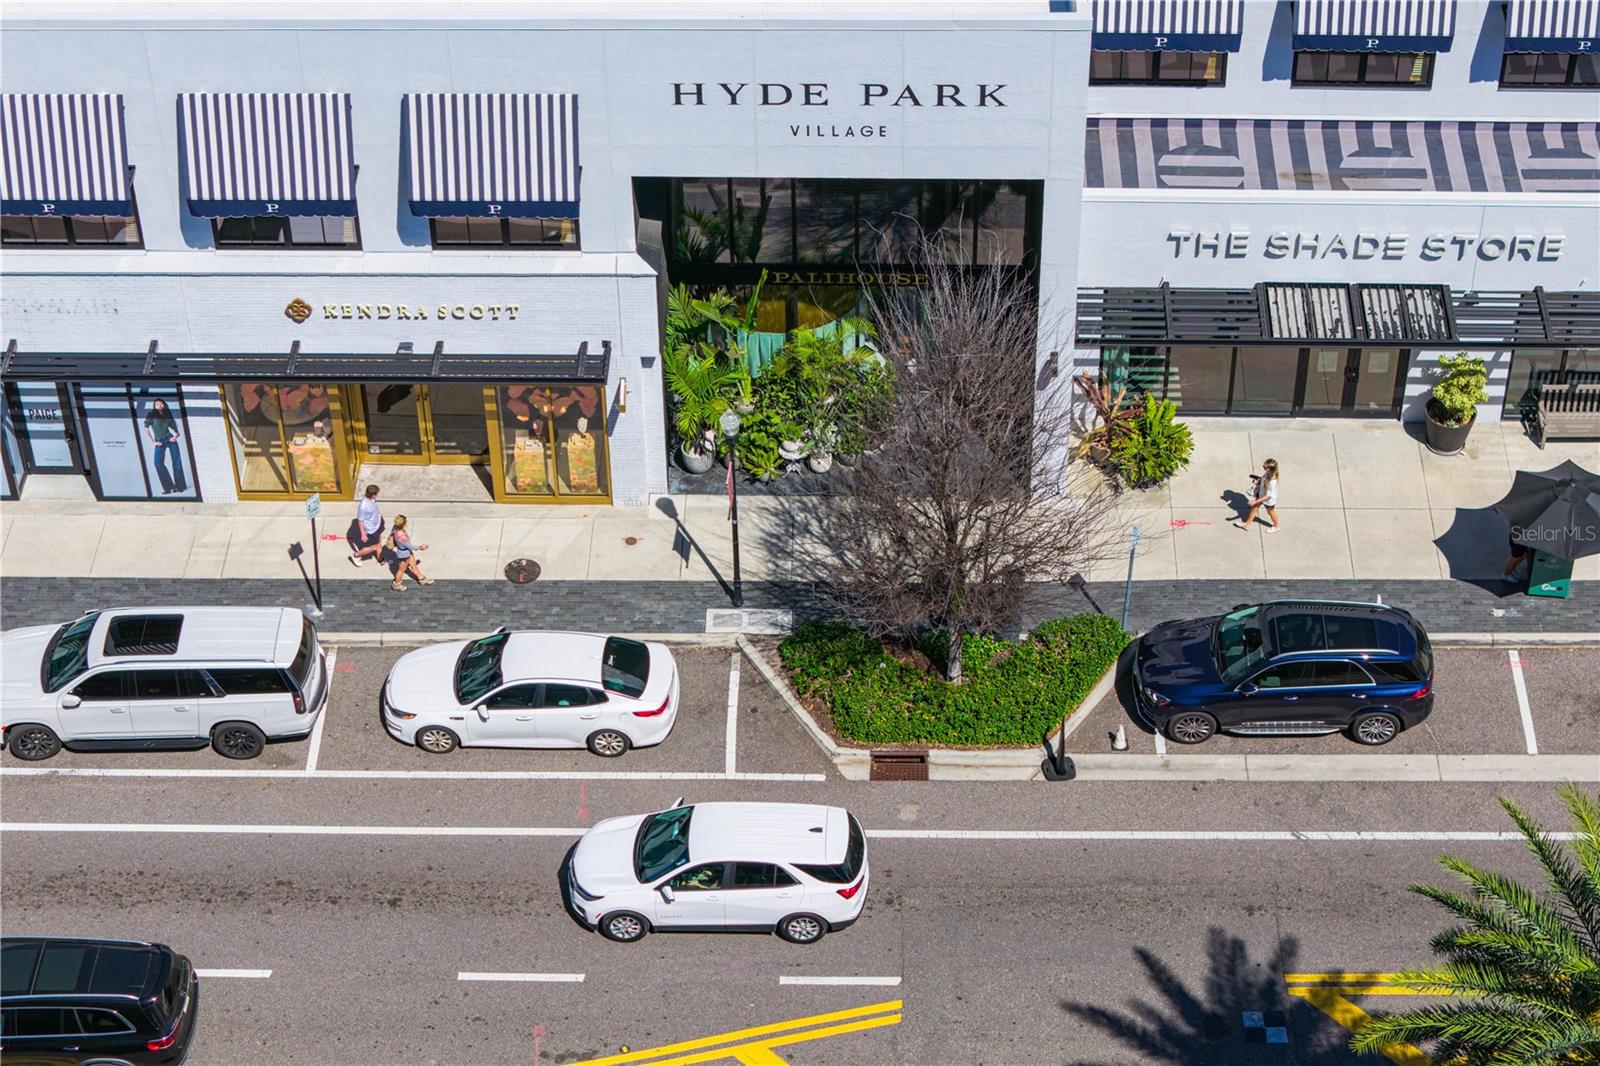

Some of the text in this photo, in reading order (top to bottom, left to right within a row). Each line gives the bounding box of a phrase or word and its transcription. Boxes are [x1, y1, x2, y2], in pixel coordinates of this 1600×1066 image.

[671, 82, 1008, 107] HYDE PARK
[790, 124, 888, 138] VILLAGE
[1166, 231, 1567, 262] THE SHADE STORE
[772, 271, 929, 285] PALIHOUSE
[323, 304, 520, 321] KENDRA SCOTT
[29, 408, 59, 421] PAIGE
